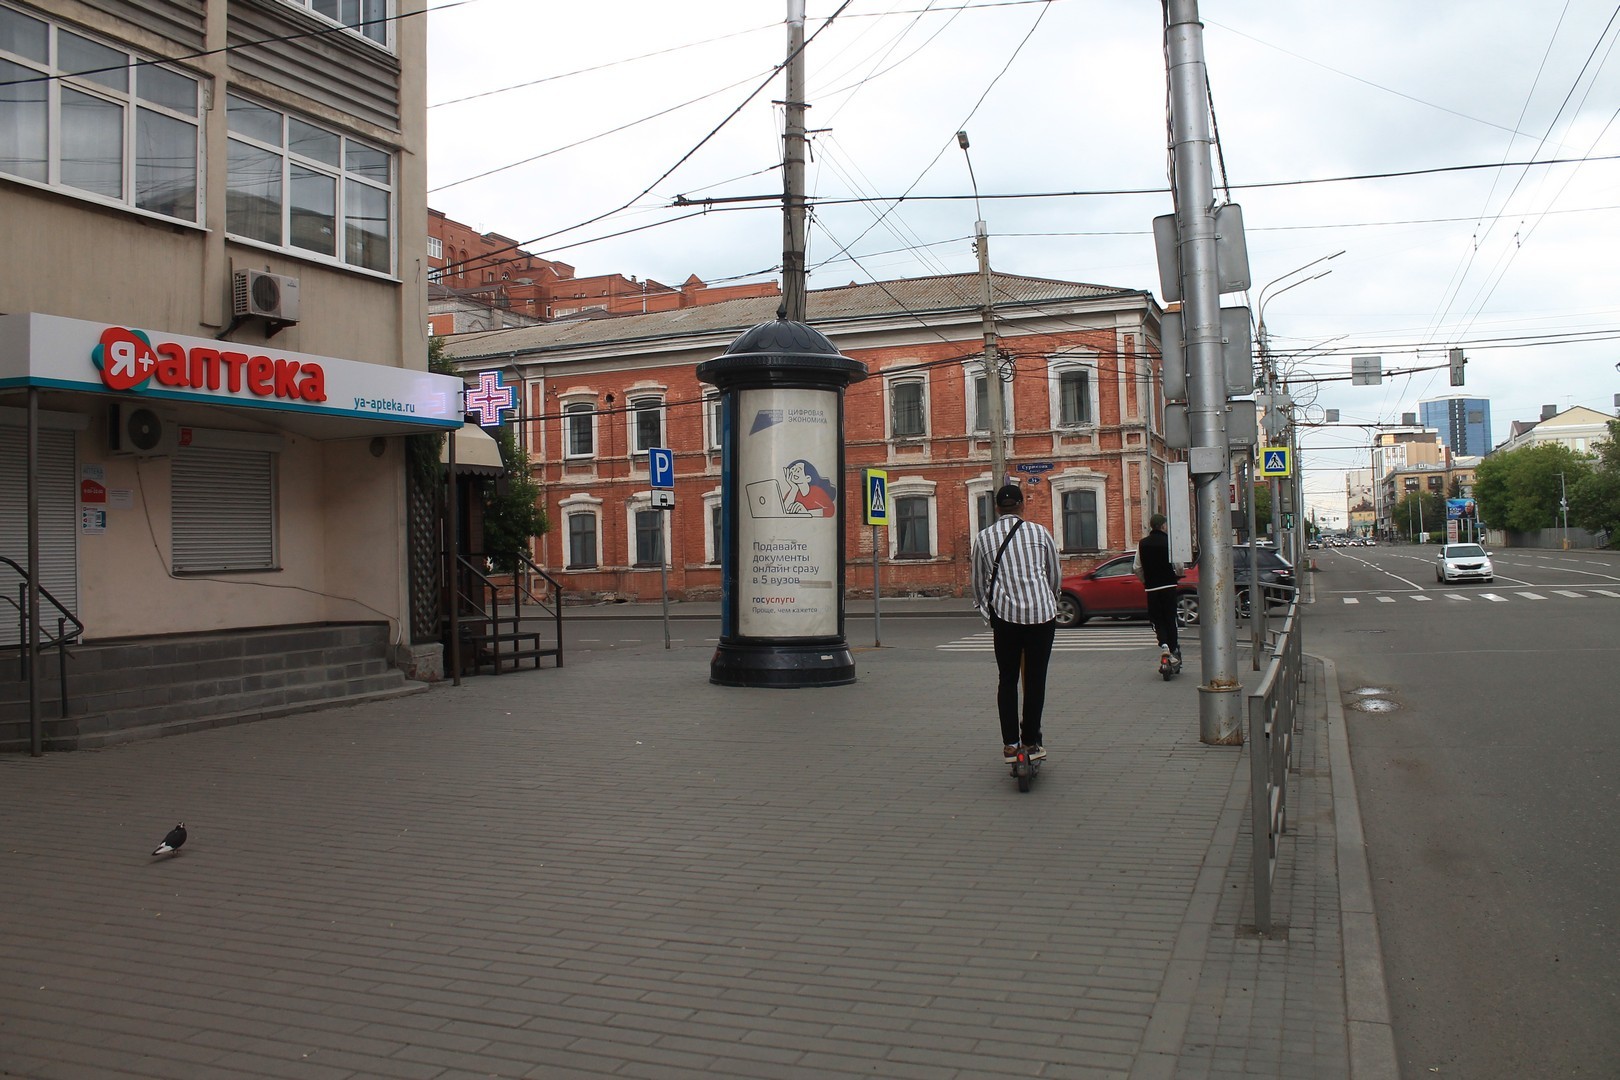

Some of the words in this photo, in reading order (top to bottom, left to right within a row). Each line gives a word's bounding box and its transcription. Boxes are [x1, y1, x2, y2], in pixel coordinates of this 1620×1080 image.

[155, 342, 328, 403] аптека
[354, 397, 415, 413] ya-apteka.ru
[655, 453, 669, 483] P
[753, 541, 807, 552] Подавайте
[753, 554, 810, 565] документы
[753, 564, 790, 573] онлайн
[793, 567, 819, 575] сразу
[761, 575, 768, 584] 5
[771, 577, 800, 586] вузов
[753, 606, 776, 614] Проще,
